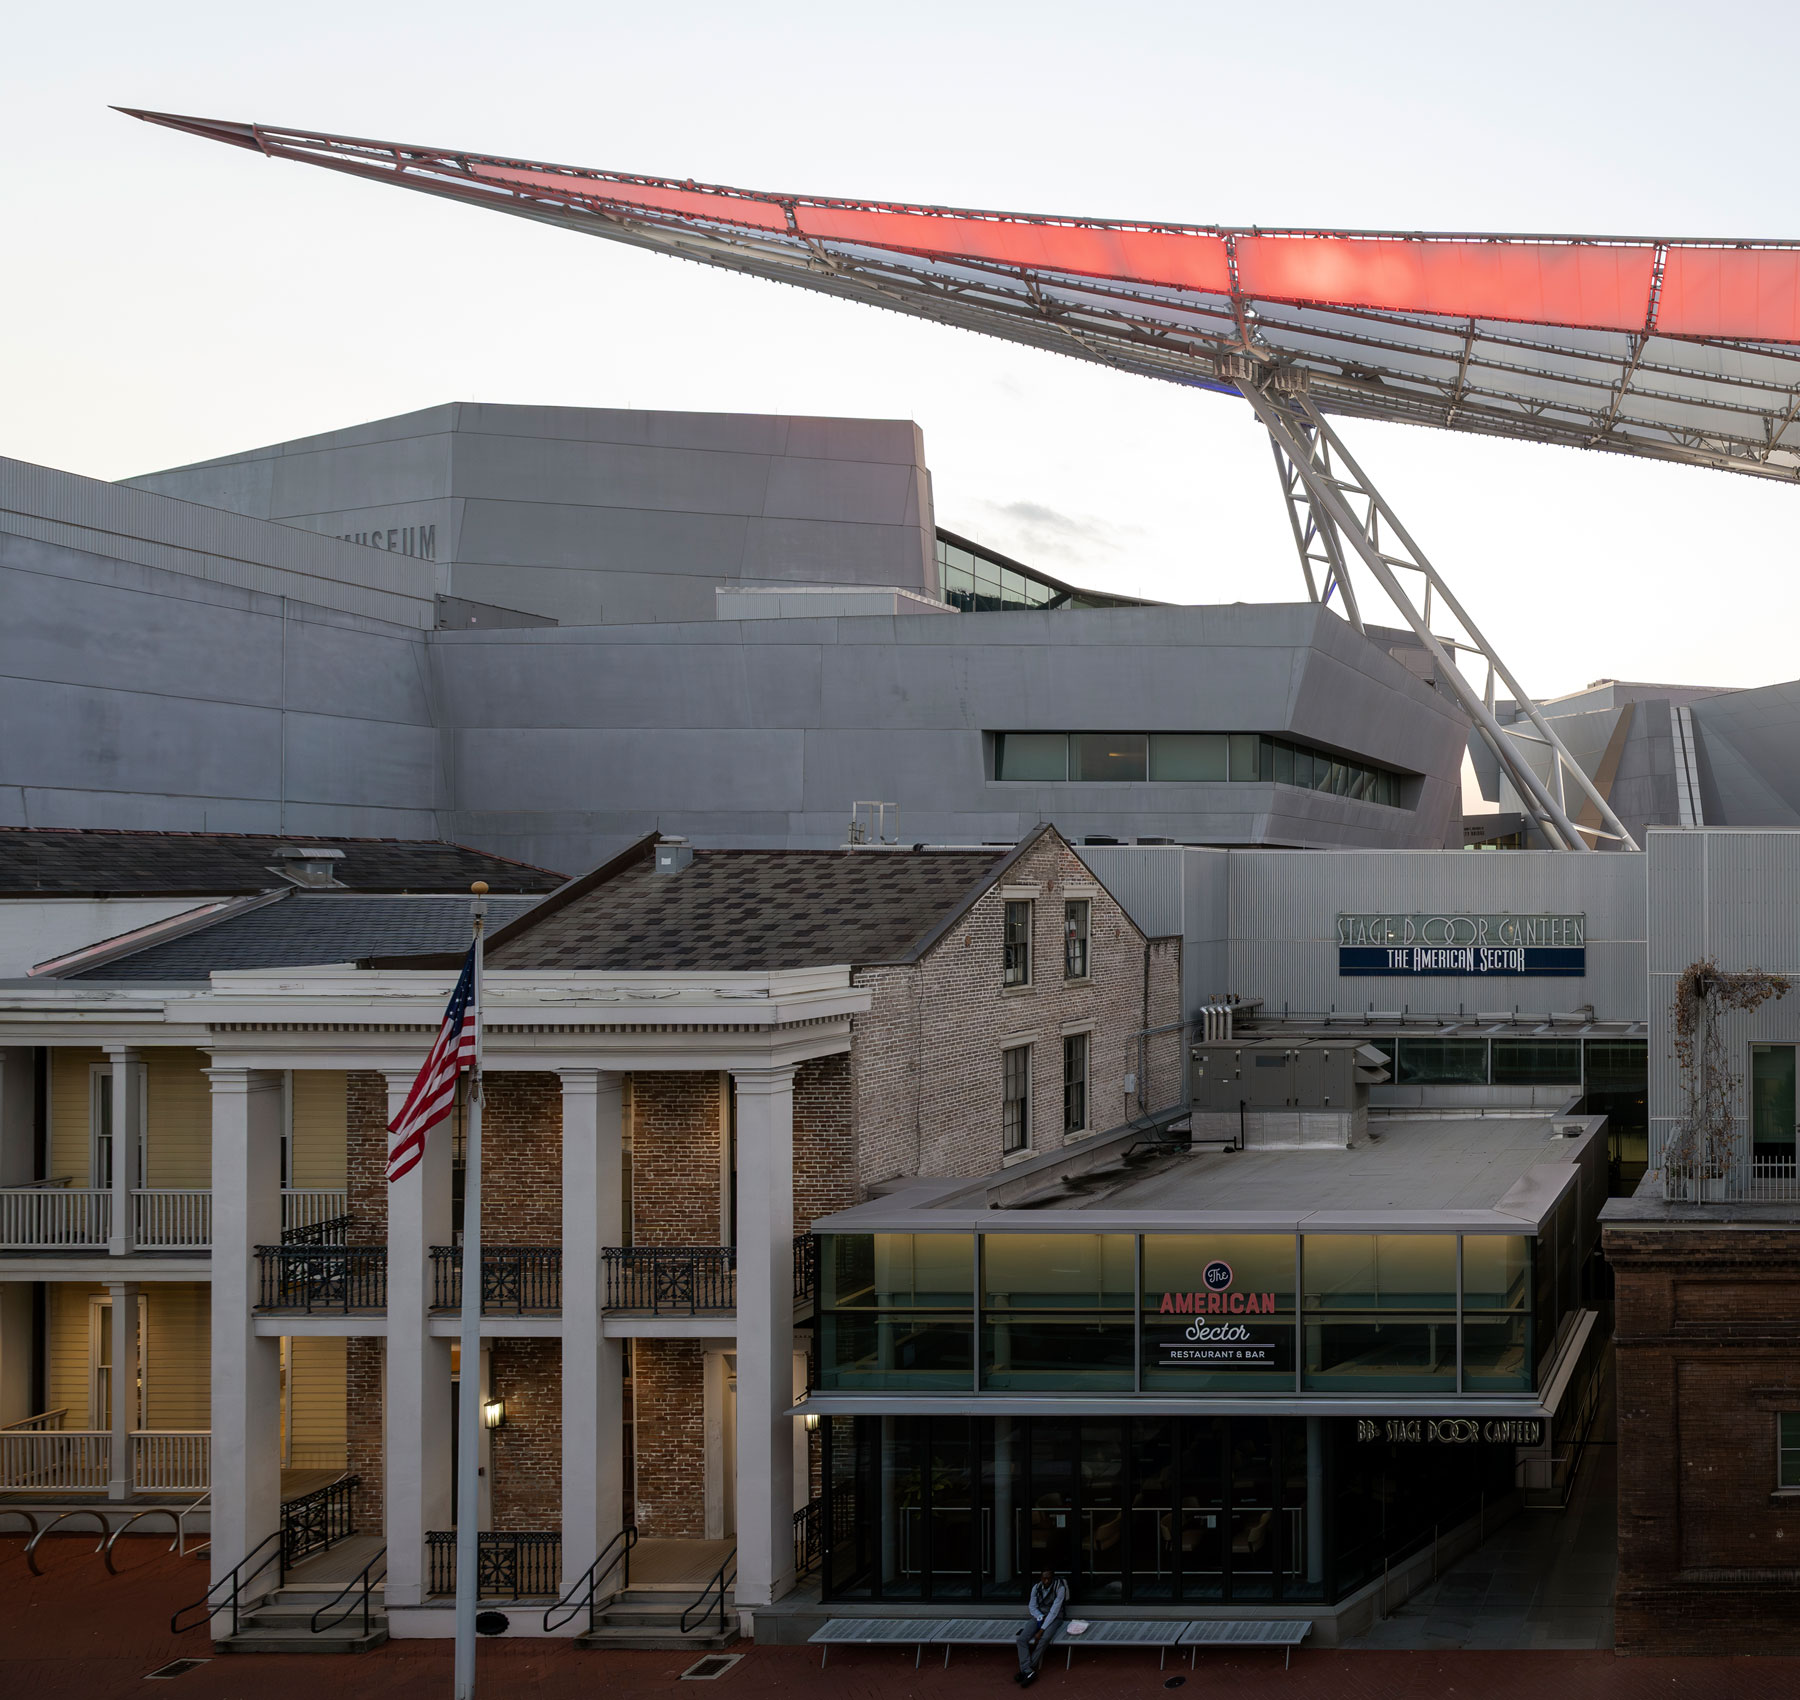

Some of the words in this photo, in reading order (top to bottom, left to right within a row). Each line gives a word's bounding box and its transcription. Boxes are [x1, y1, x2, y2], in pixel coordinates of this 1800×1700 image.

[1337, 918, 1392, 945] STAGE
[1404, 917, 1488, 945] DOOR
[1499, 918, 1585, 946] CANTEEN
[1387, 949, 1409, 968] THE
[1413, 947, 1474, 972] AMERICAN
[1480, 947, 1525, 972] SECTOR
[1207, 1268, 1229, 1283] The
[1160, 1292, 1275, 1314] AMERICAN
[1185, 1316, 1250, 1341] Sector
[1170, 1350, 1234, 1358] RESTAURANT
[1236, 1350, 1242, 1358] &
[1245, 1350, 1265, 1358] BAR
[1386, 1420, 1422, 1443] STAGE
[1428, 1419, 1480, 1443] DOOR
[1484, 1420, 1540, 1443] CANTEEN
